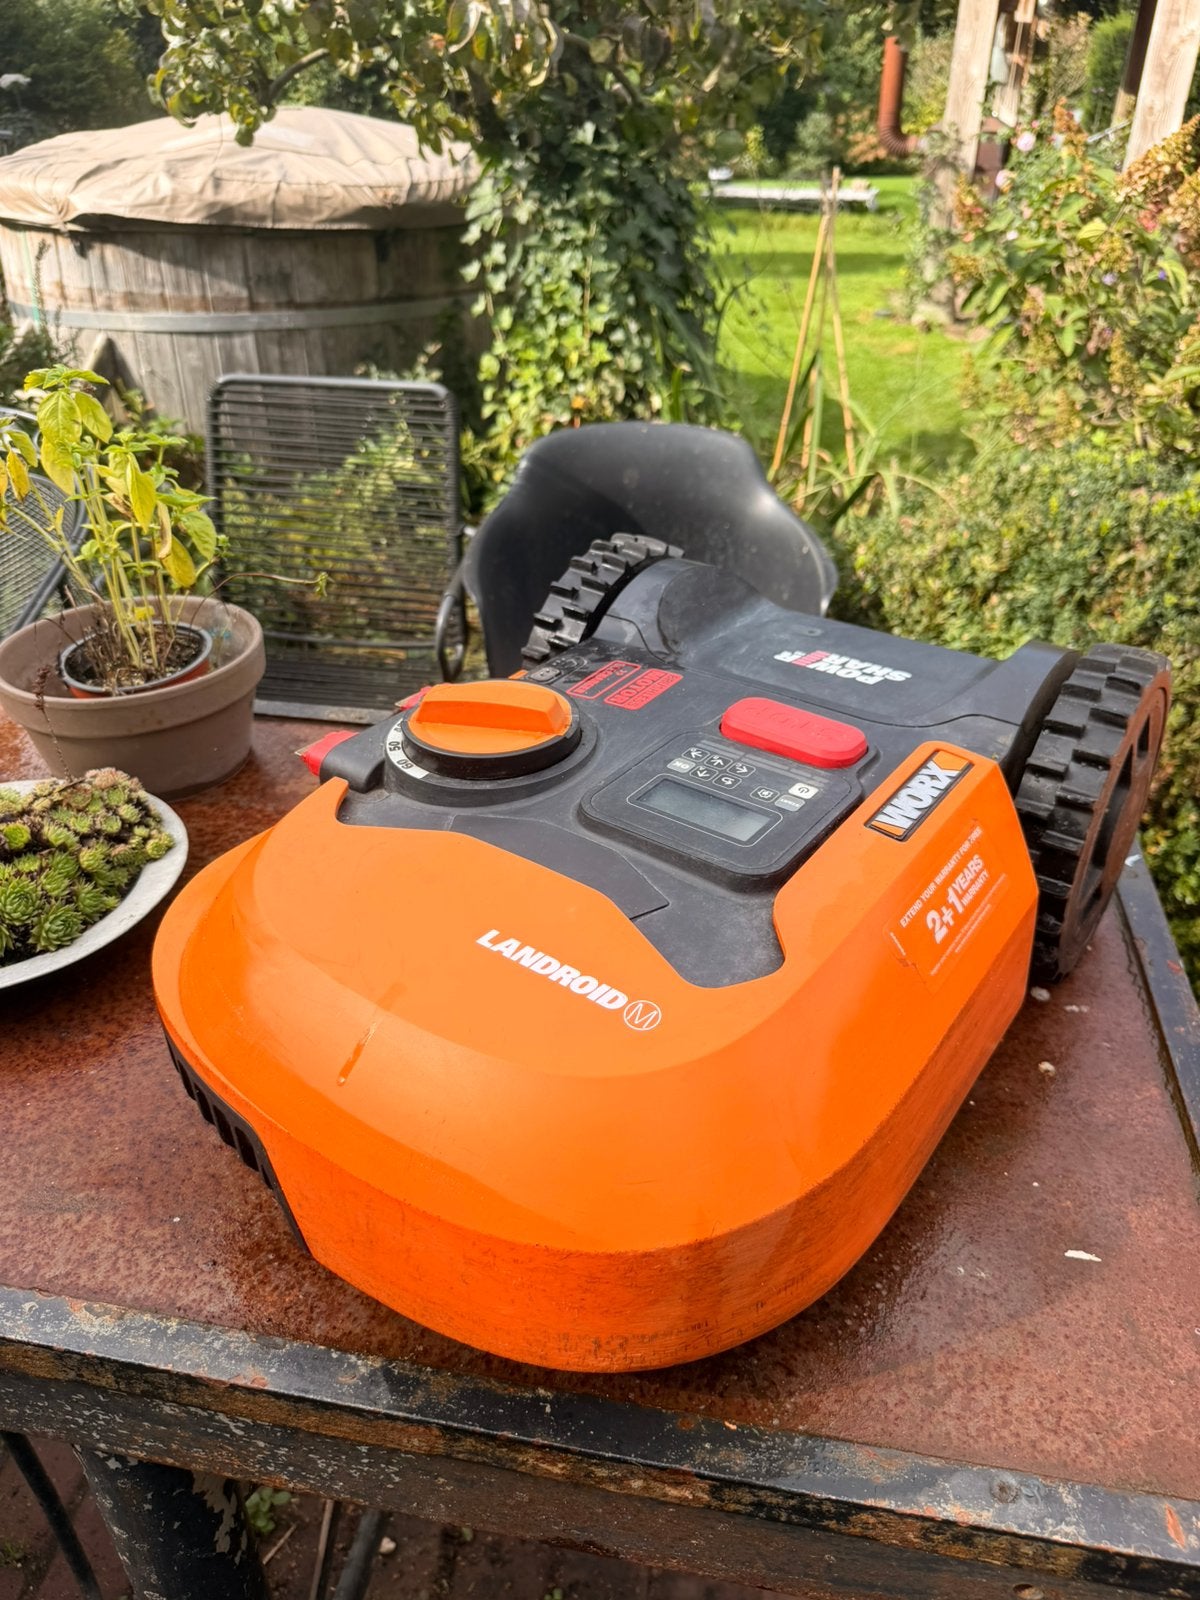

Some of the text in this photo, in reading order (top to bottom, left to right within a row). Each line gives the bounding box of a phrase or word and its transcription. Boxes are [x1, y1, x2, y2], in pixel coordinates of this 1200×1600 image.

[609, 669, 667, 703] MOTOR
[388, 741, 401, 751] 50
[396, 759, 414, 769] 60
[672, 761, 690, 769] OK
[874, 760, 960, 829] WORX
[900, 898, 923, 928] EXTEND
[920, 881, 938, 902] YOUR
[935, 853, 961, 885] WARRANTY
[926, 886, 964, 944] 2+1
[951, 854, 984, 894] YEARS
[961, 869, 989, 907] WARRANTY
[475, 929, 659, 1029] LANDROID M
